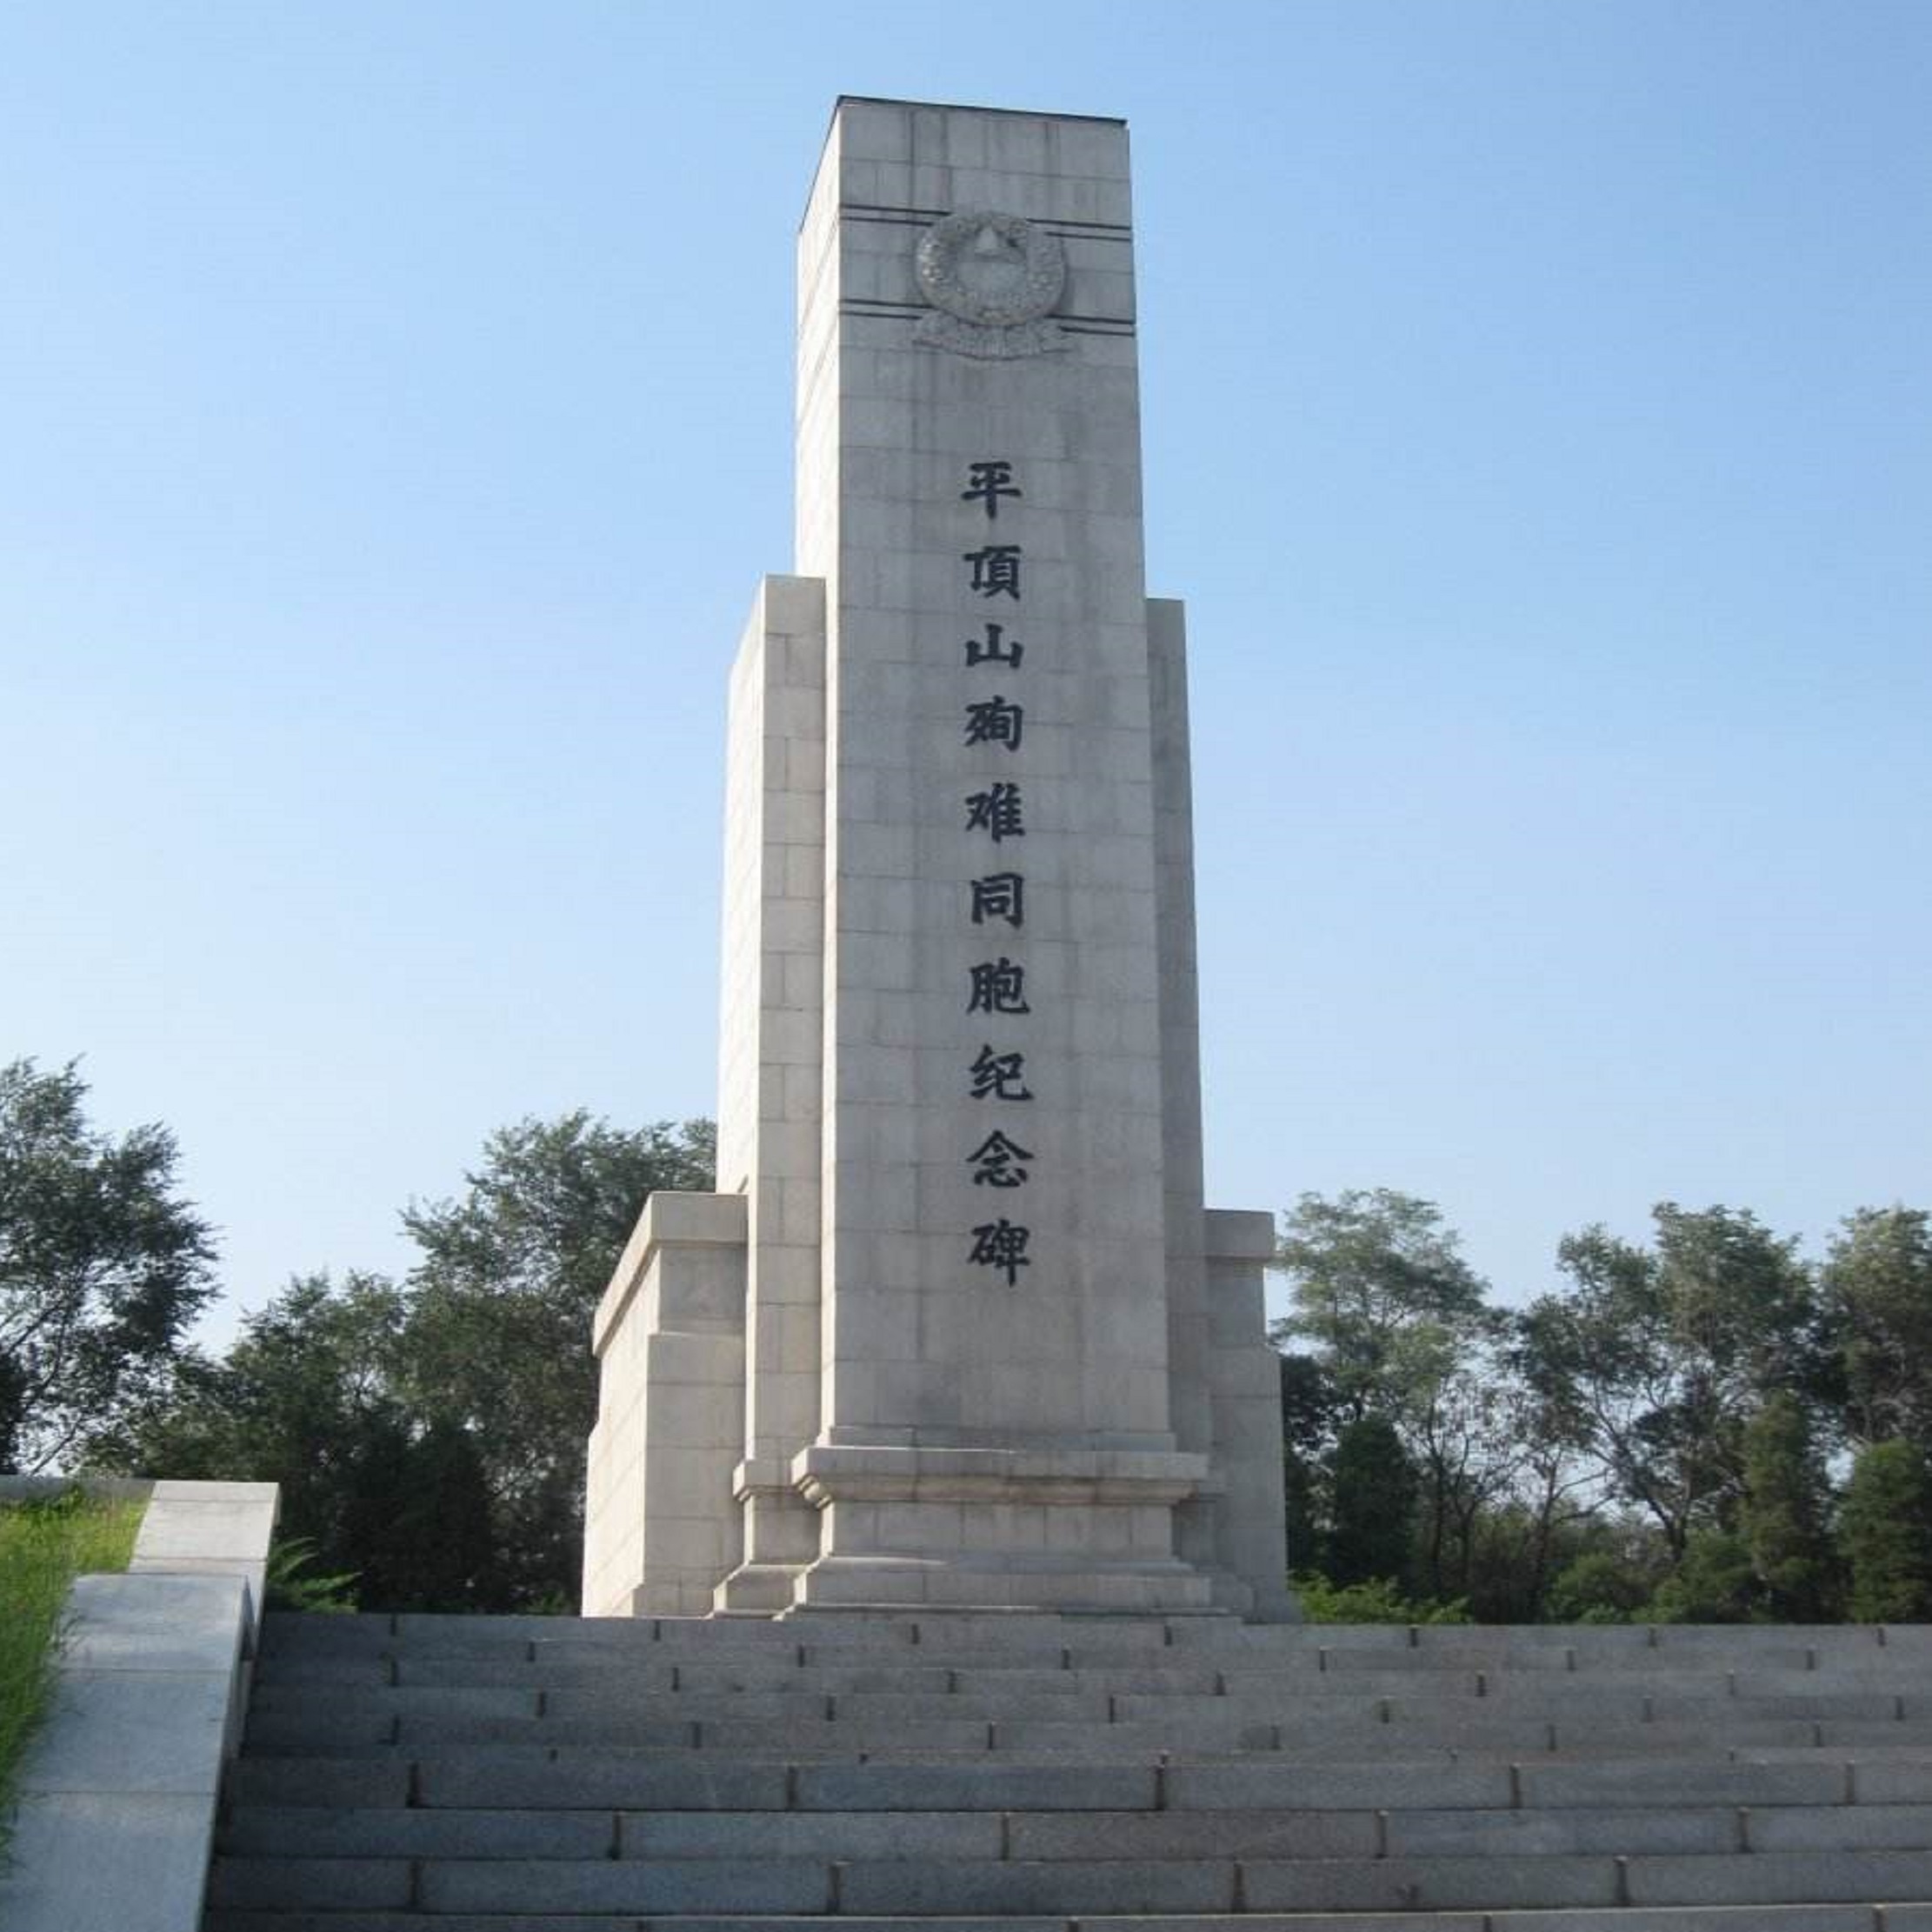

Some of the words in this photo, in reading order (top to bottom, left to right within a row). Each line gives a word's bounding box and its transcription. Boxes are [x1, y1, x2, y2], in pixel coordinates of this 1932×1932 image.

[961, 460, 1035, 1287] 平頂山殉难同胞纪念碑
